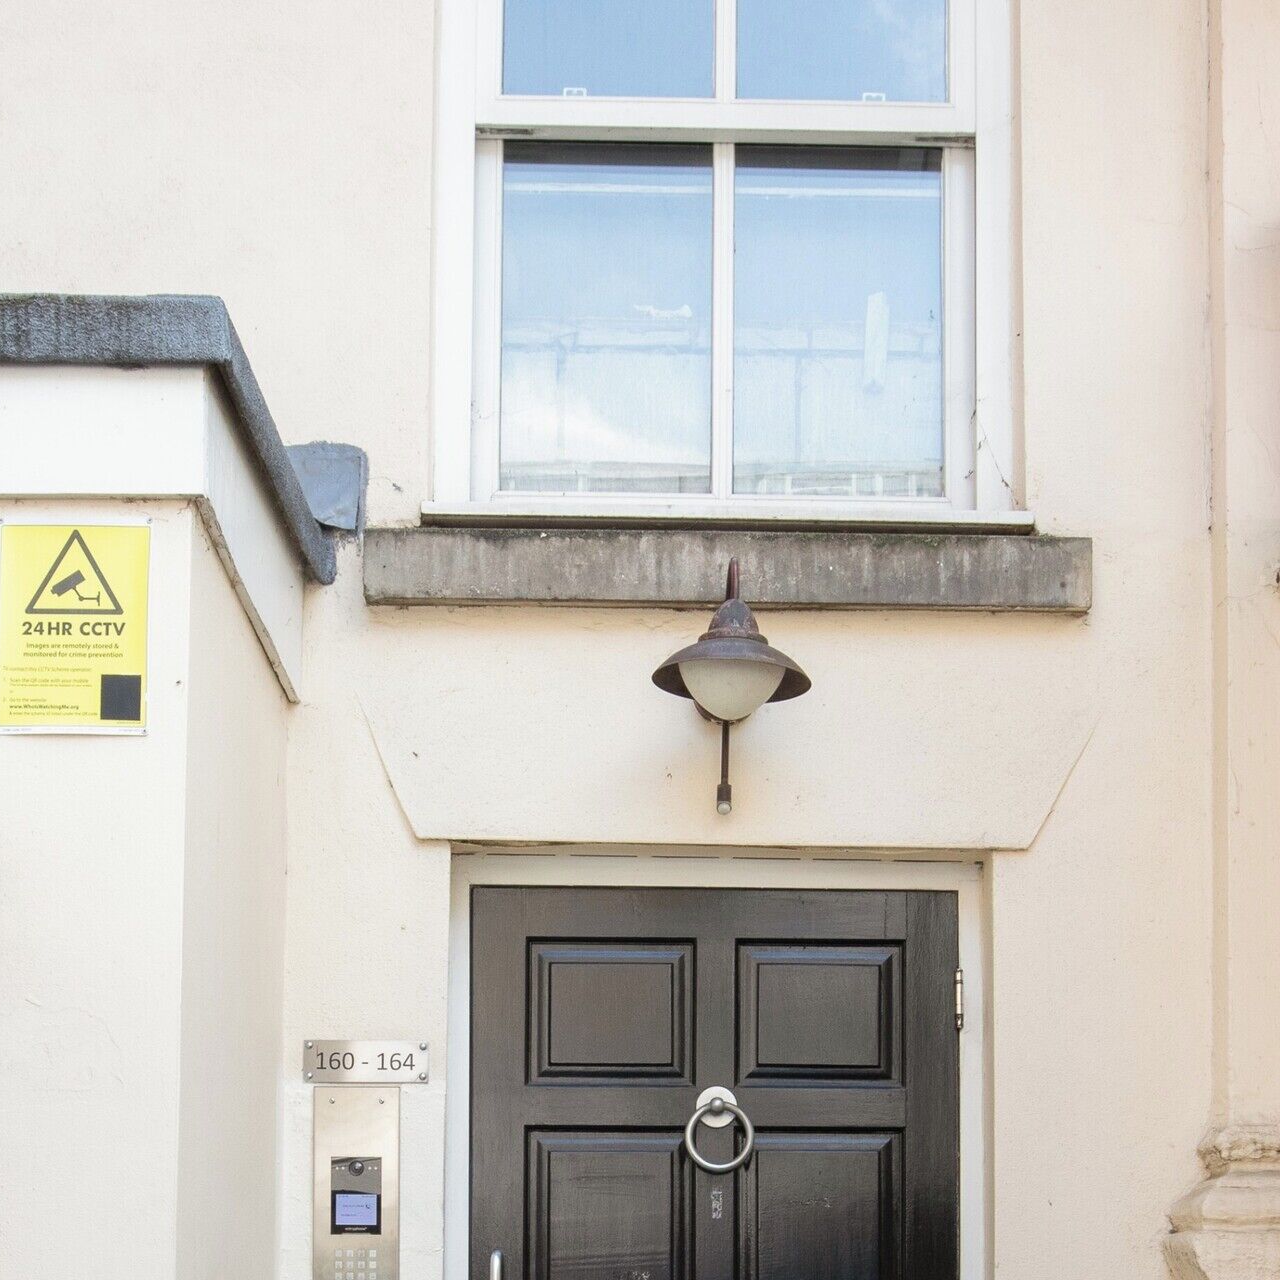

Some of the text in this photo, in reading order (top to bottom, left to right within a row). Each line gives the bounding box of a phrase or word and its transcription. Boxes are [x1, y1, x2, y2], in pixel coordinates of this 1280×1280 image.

[79, 621, 126, 636] CCTV
[26, 642, 49, 650] Images
[62, 642, 91, 650] remotely
[88, 651, 123, 659] prevention
[316, 1052, 354, 1070] 160
[377, 1053, 416, 1071] 164
